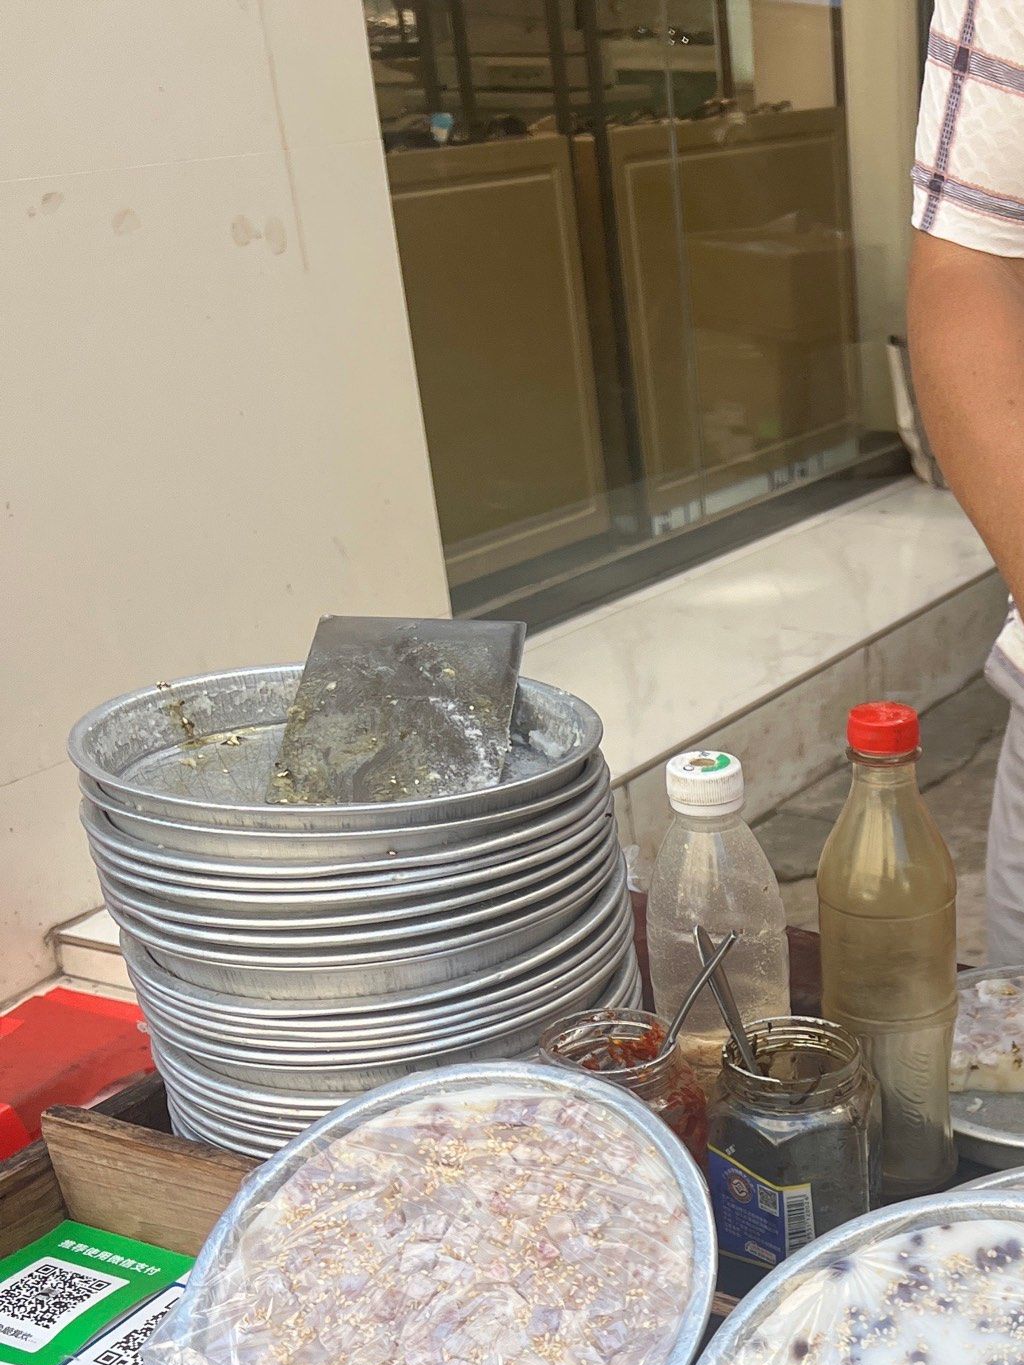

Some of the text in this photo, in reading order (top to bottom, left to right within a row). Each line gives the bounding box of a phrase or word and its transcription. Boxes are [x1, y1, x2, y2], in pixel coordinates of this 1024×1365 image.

[58, 1239, 162, 1275] 推荐使用微信支付
